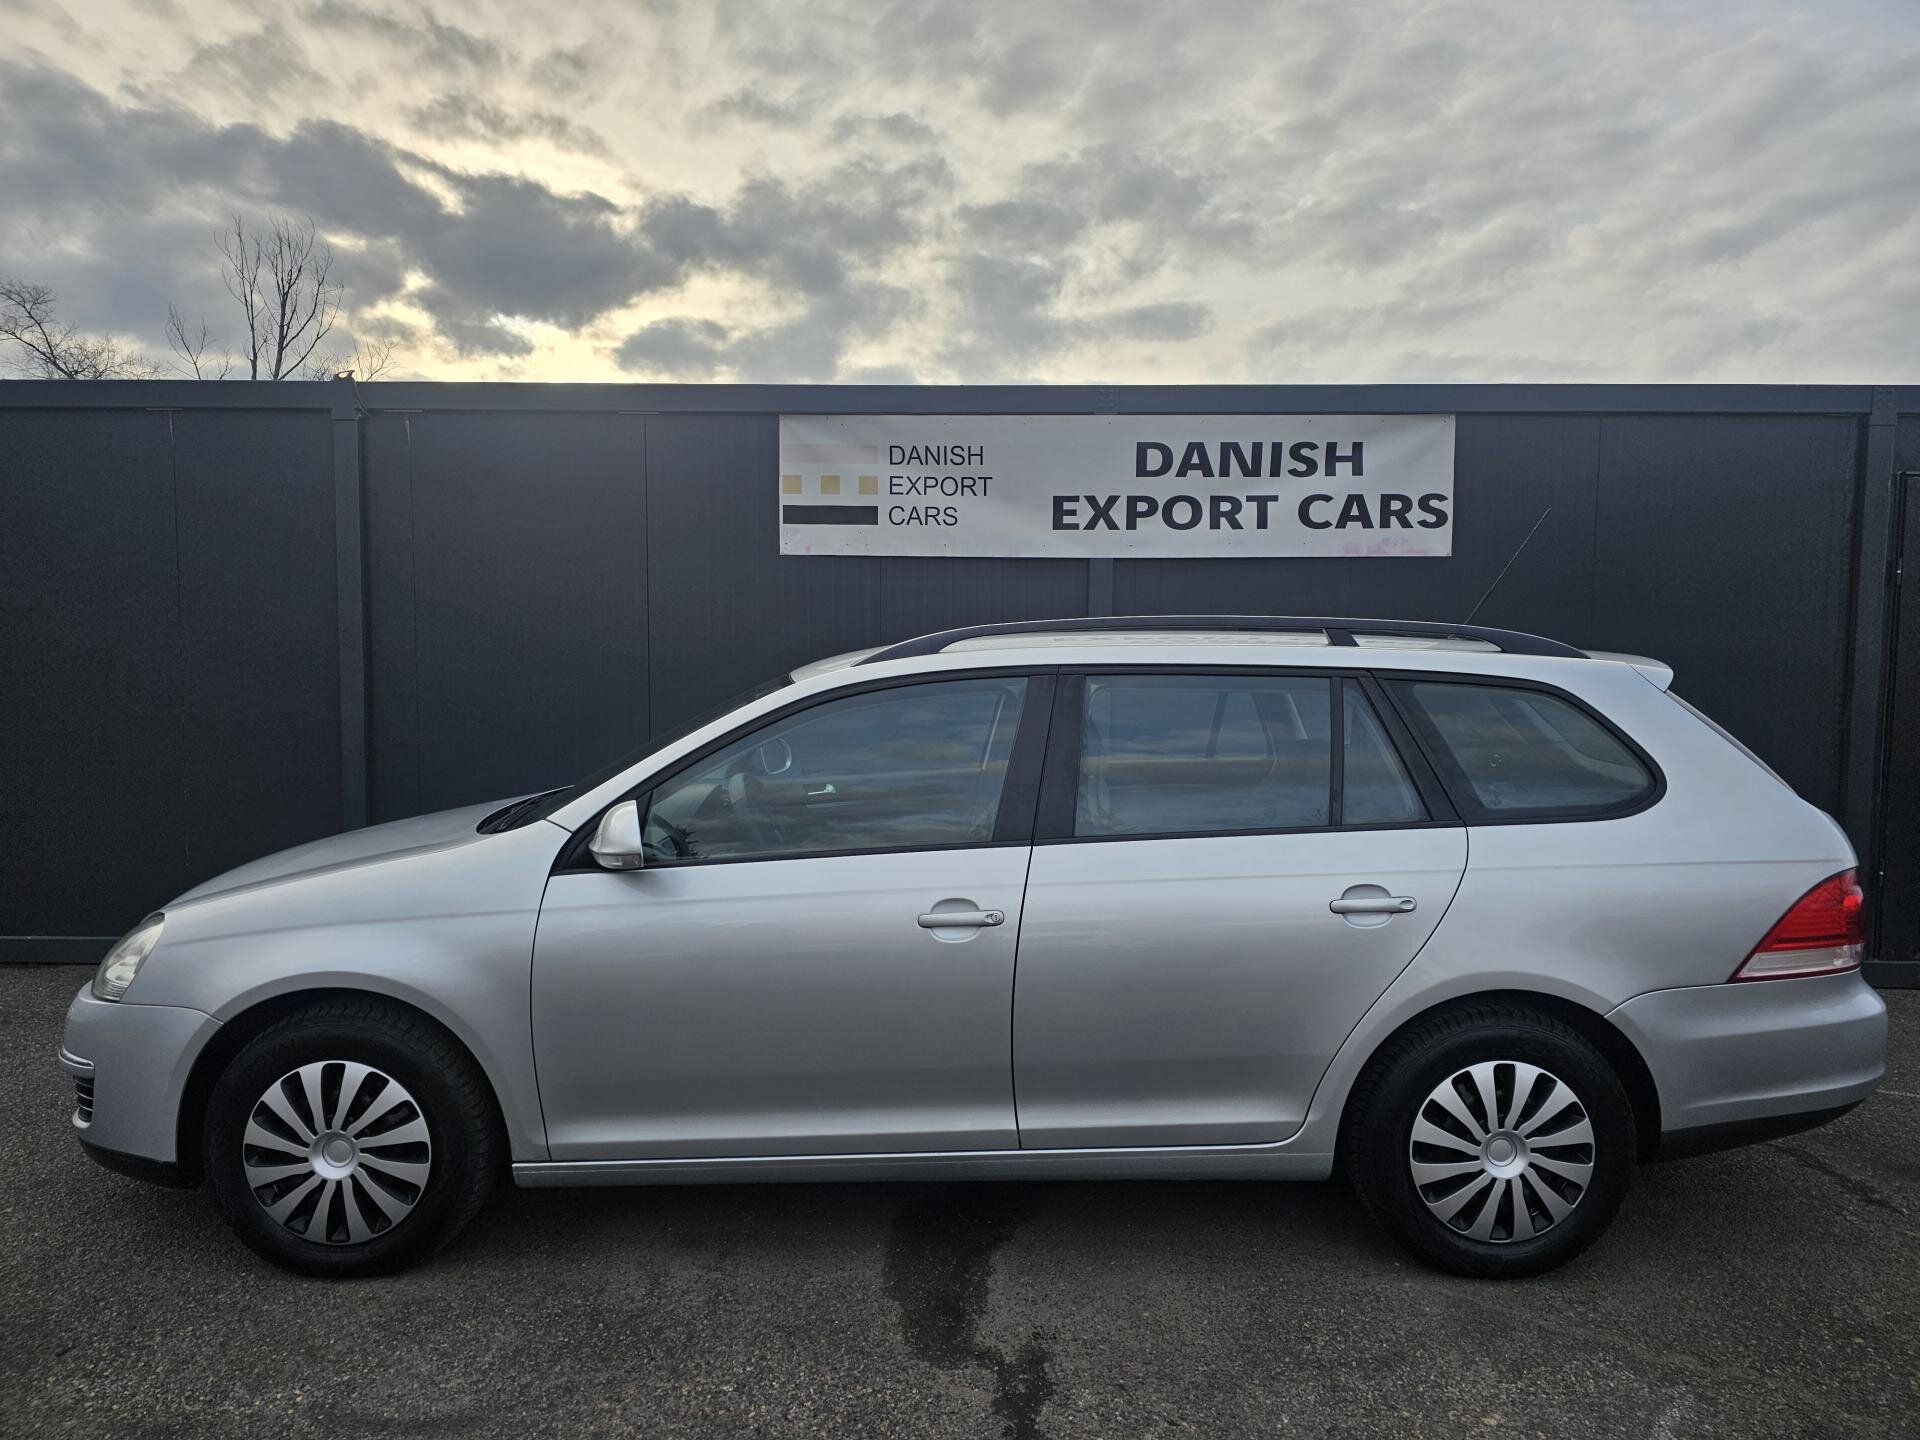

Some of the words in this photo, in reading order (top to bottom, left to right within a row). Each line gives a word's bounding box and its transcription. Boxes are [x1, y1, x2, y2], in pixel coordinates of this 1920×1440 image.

[889, 444, 984, 466] DANISH
[1136, 441, 1364, 478] DANISH
[889, 475, 993, 497] EXPORT
[888, 505, 959, 527] CARS
[1052, 494, 1279, 531] EXPORT
[1297, 492, 1449, 529] CARS
